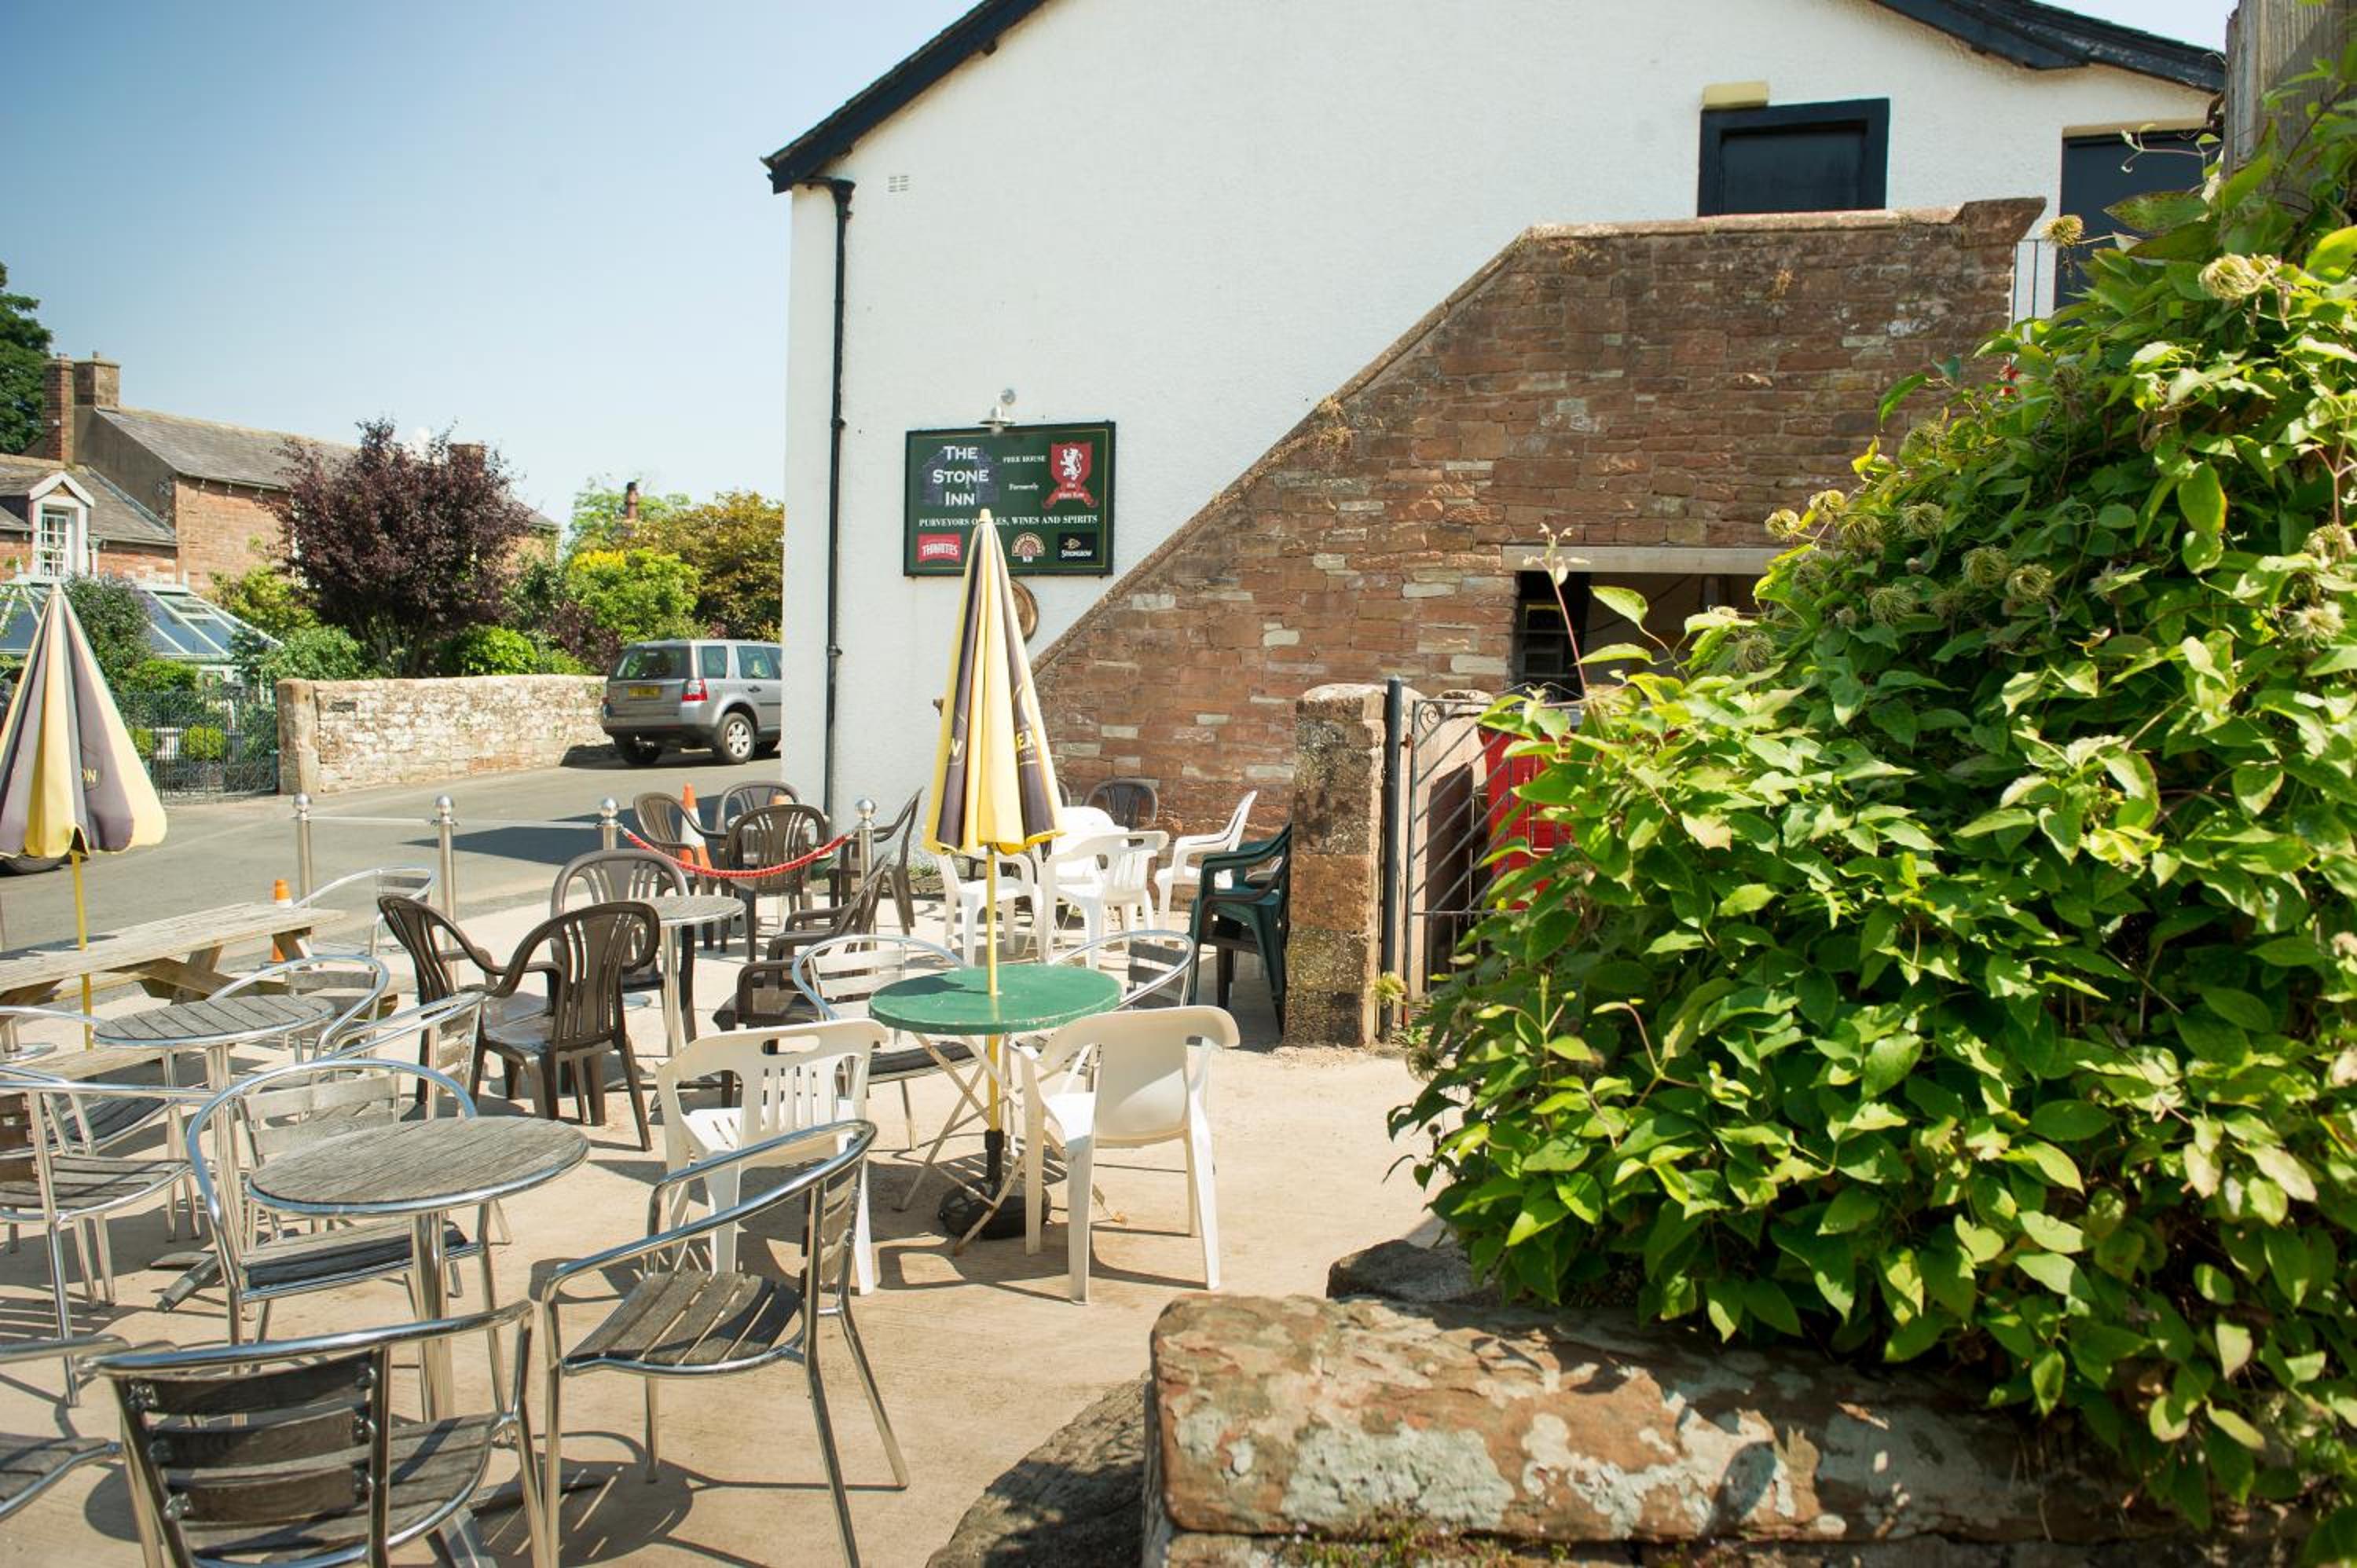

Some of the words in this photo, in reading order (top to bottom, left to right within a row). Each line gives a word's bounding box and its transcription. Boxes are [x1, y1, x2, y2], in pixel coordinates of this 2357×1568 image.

[943, 445, 978, 460] THE
[933, 469, 989, 485] STONE
[945, 492, 975, 506] INN
[918, 517, 970, 527] PURVEYORS
[1011, 515, 1040, 526] WINES
[1041, 515, 1061, 525] AND
[1062, 514, 1098, 524] SPIRITS
